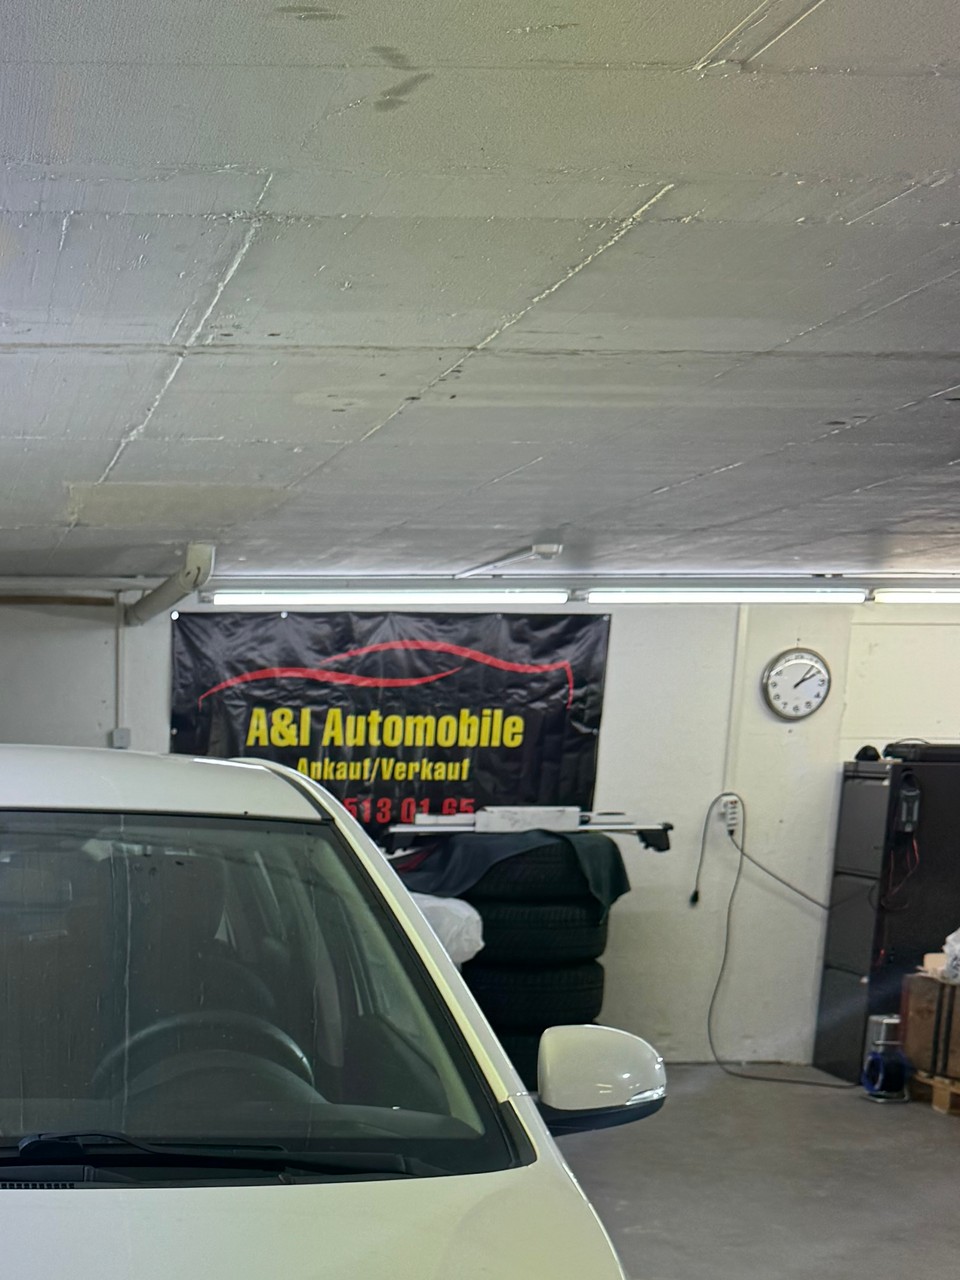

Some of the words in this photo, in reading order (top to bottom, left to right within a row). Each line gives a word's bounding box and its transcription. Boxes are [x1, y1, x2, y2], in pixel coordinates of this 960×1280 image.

[246, 707, 311, 747] A&I
[322, 707, 525, 748] Automobile
[297, 757, 470, 782] Ankauf/Verkauf
